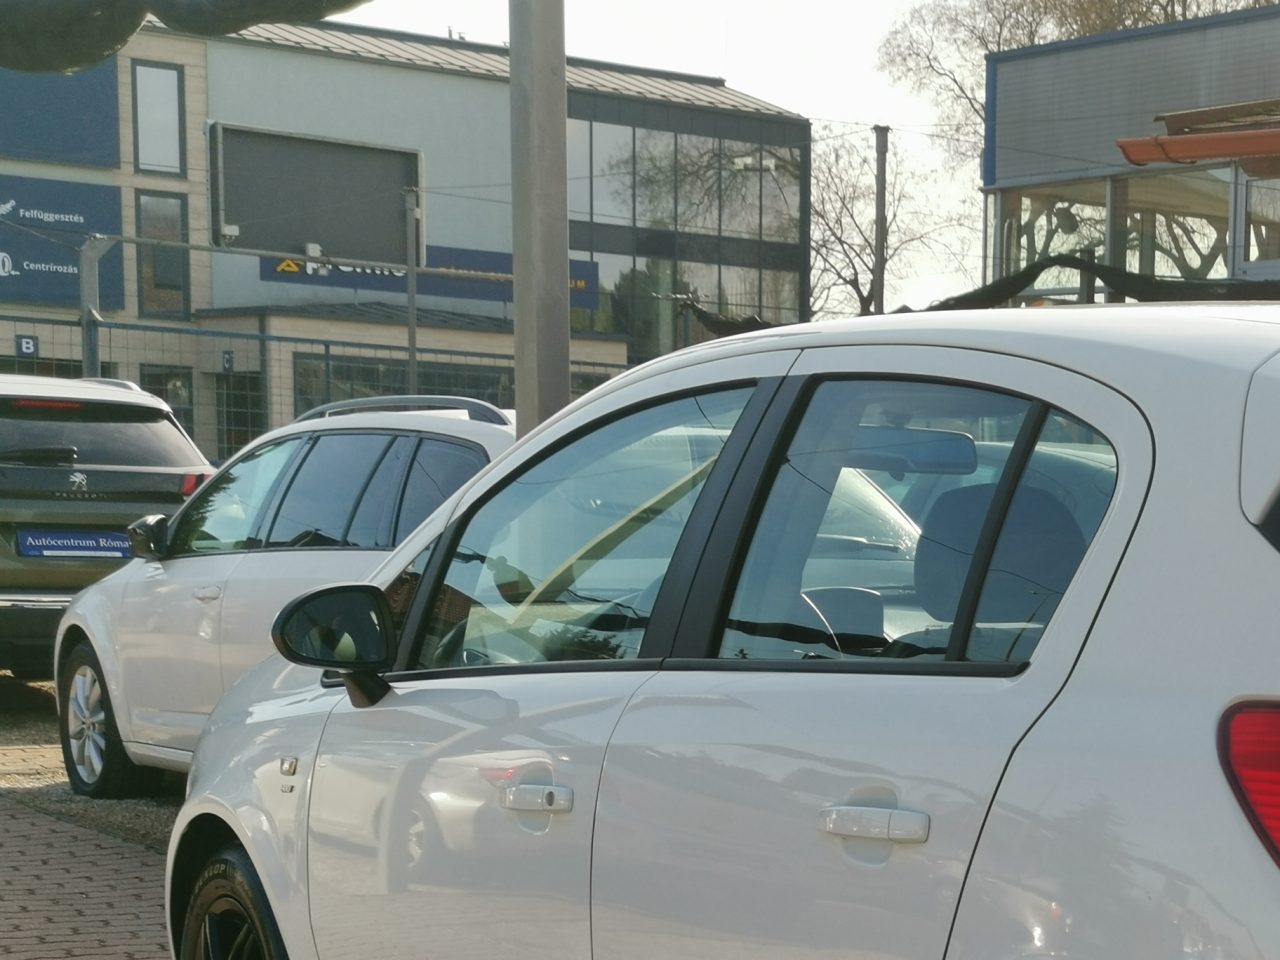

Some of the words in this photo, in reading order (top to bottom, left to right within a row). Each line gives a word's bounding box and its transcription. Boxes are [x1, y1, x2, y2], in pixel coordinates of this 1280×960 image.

[19, 208, 84, 224] Felfüggesztés
[21, 339, 34, 353] B
[26, 537, 96, 547] Autócentrum
